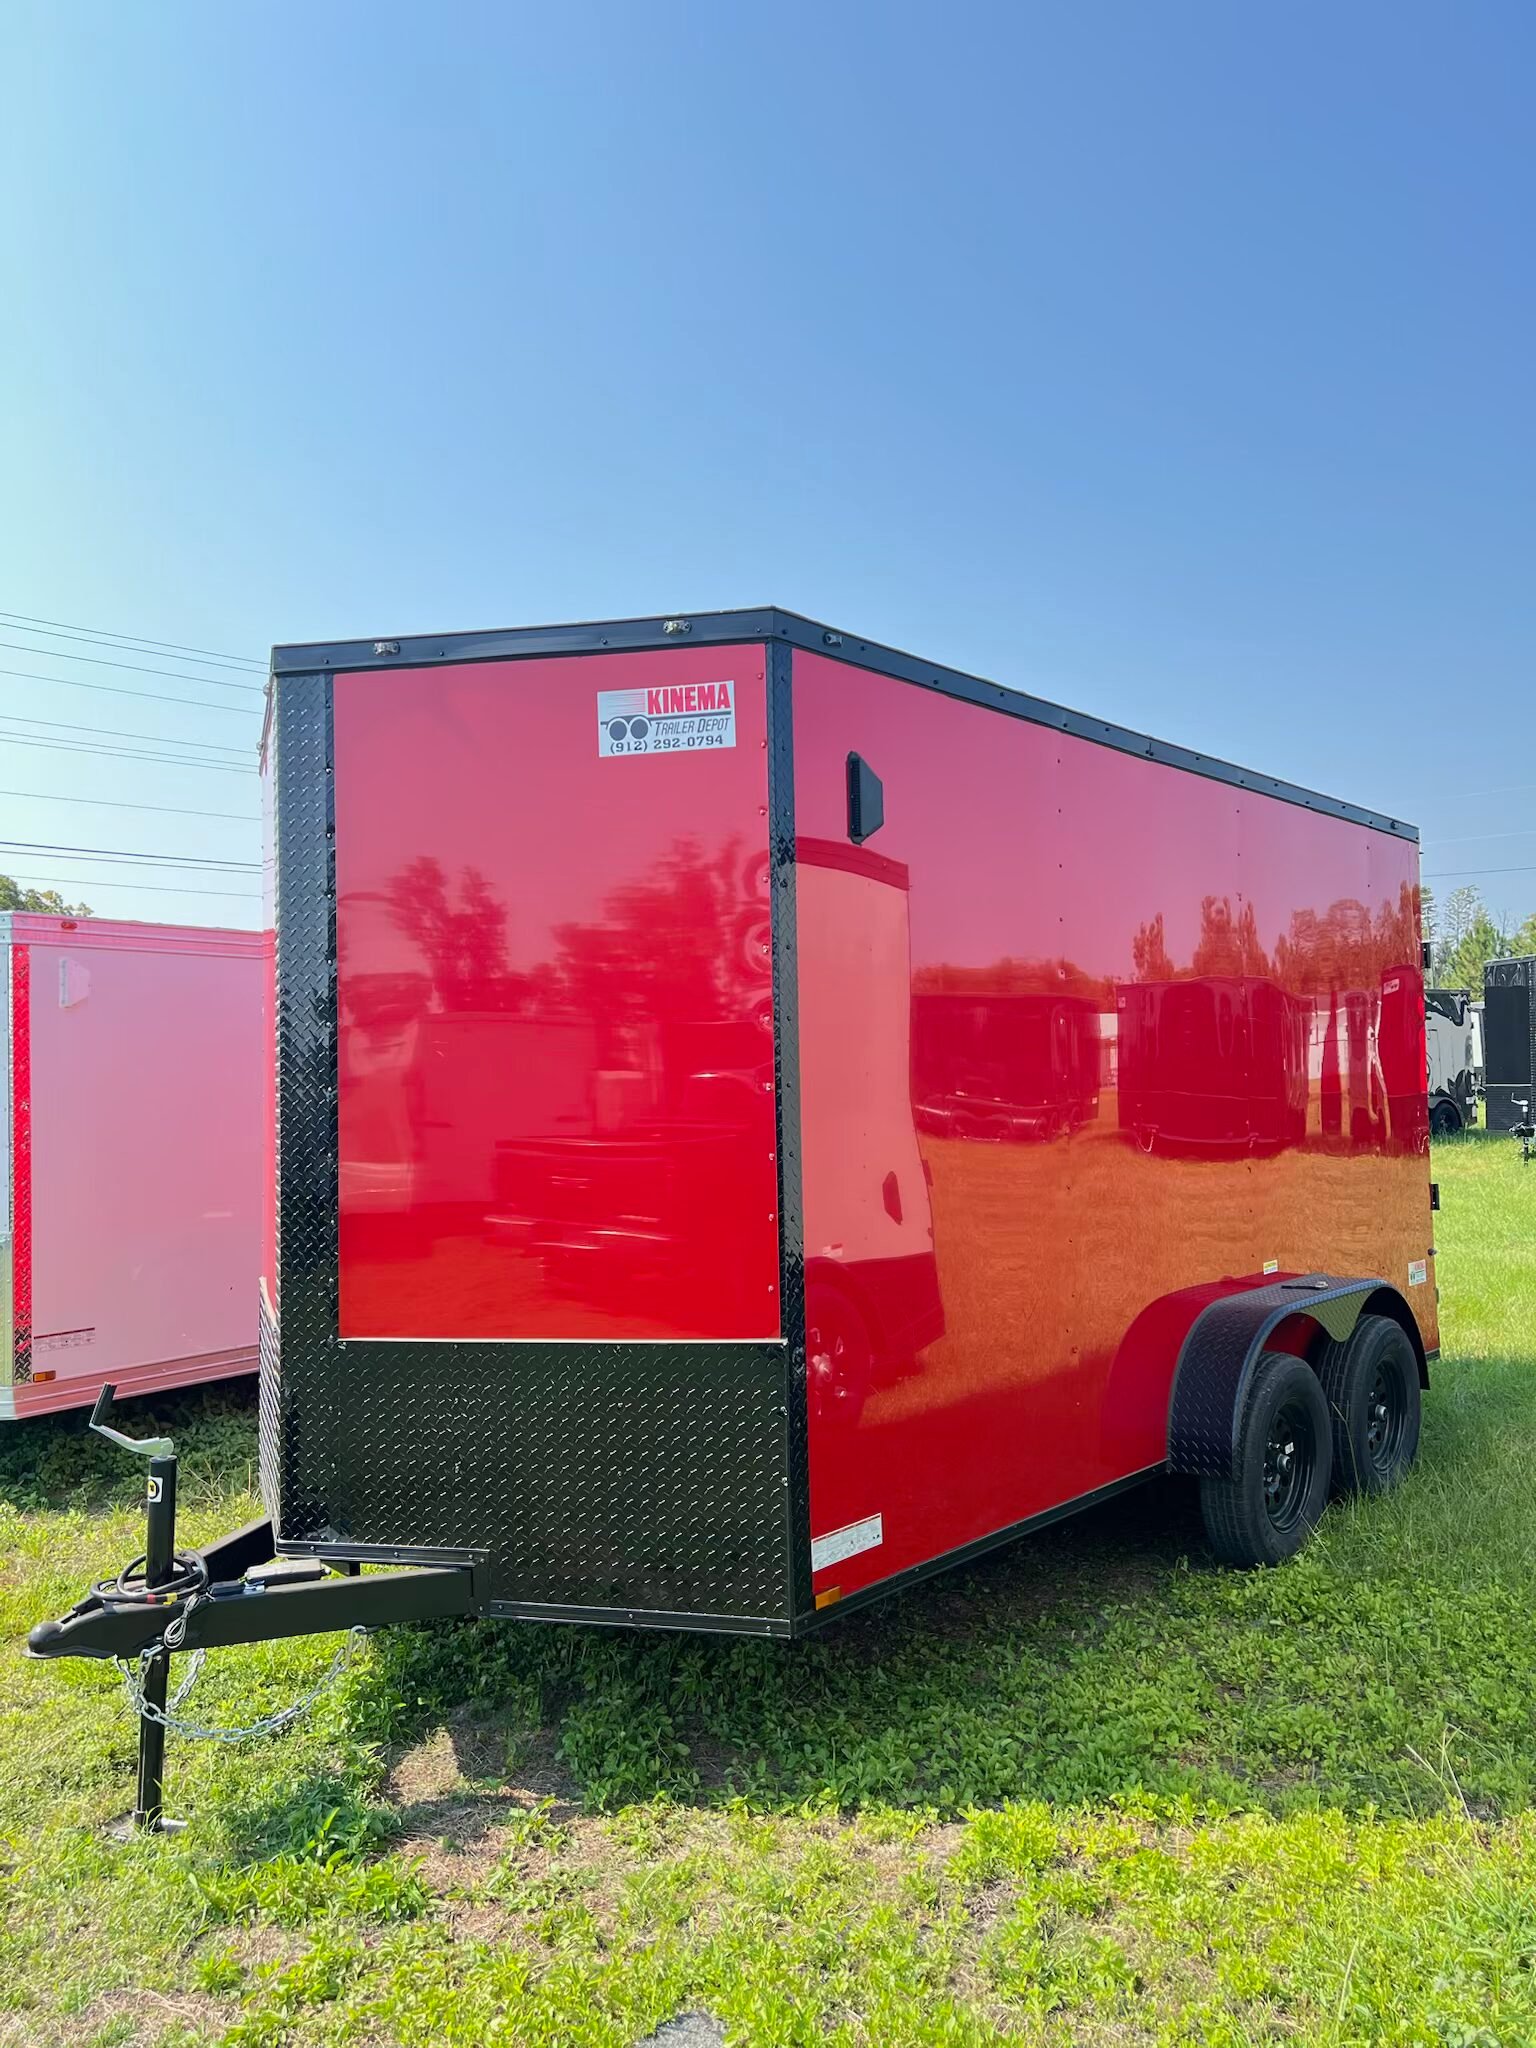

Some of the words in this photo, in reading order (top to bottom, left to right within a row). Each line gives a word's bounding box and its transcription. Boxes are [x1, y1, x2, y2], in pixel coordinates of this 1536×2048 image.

[647, 683, 731, 715] KINEMA
[655, 720, 695, 737] TRAILER
[697, 717, 731, 733] DEPOT
[610, 740, 648, 755] (912)
[653, 734, 723, 750] 292-0794
